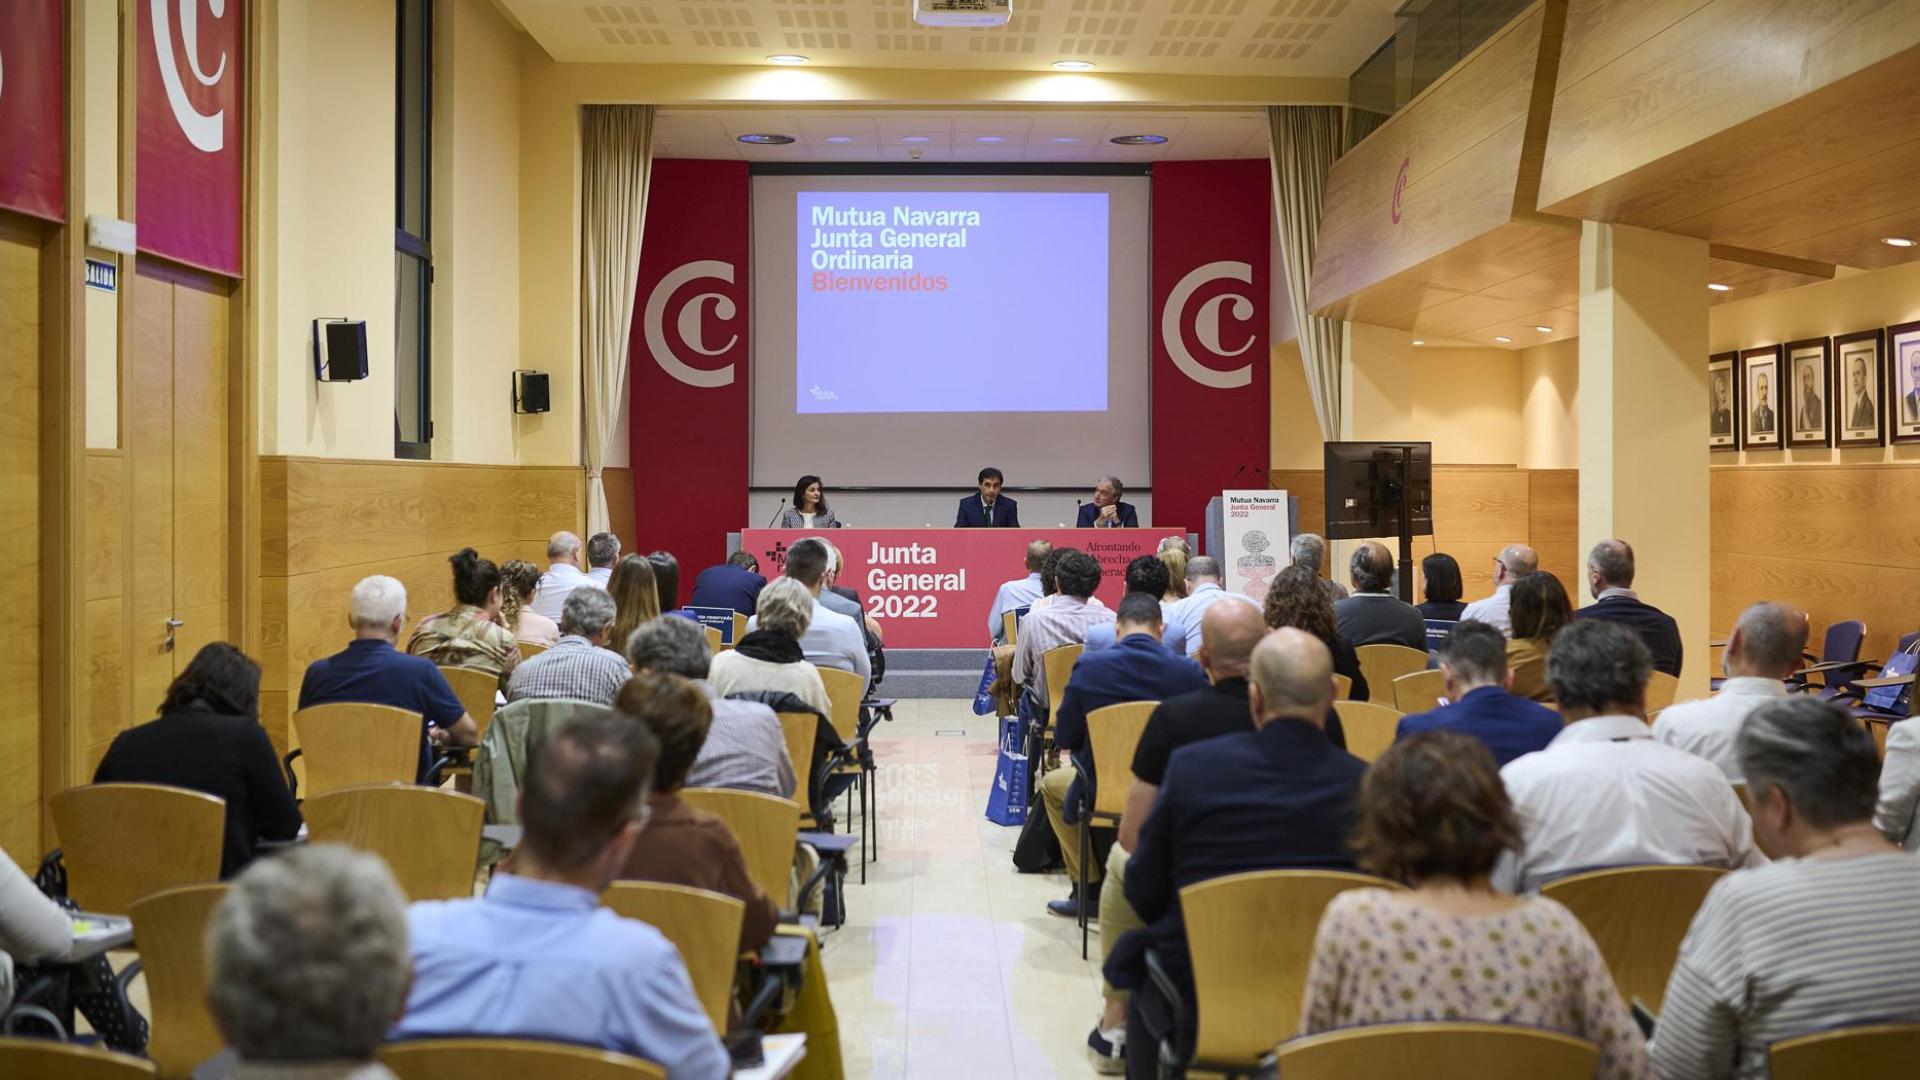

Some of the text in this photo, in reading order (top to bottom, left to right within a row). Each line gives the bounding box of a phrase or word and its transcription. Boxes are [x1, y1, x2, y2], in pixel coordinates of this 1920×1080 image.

[811, 206, 981, 226] Mutua Navarra
[811, 227, 967, 248] Junta General
[811, 249, 914, 270] Ordinaria
[85, 262, 114, 287] SALIDA
[812, 271, 948, 292] Bienvenidos
[867, 541, 937, 565] Junta
[1086, 542, 1141, 552] Afrontando
[867, 568, 966, 591] General
[867, 595, 938, 618] 2022
